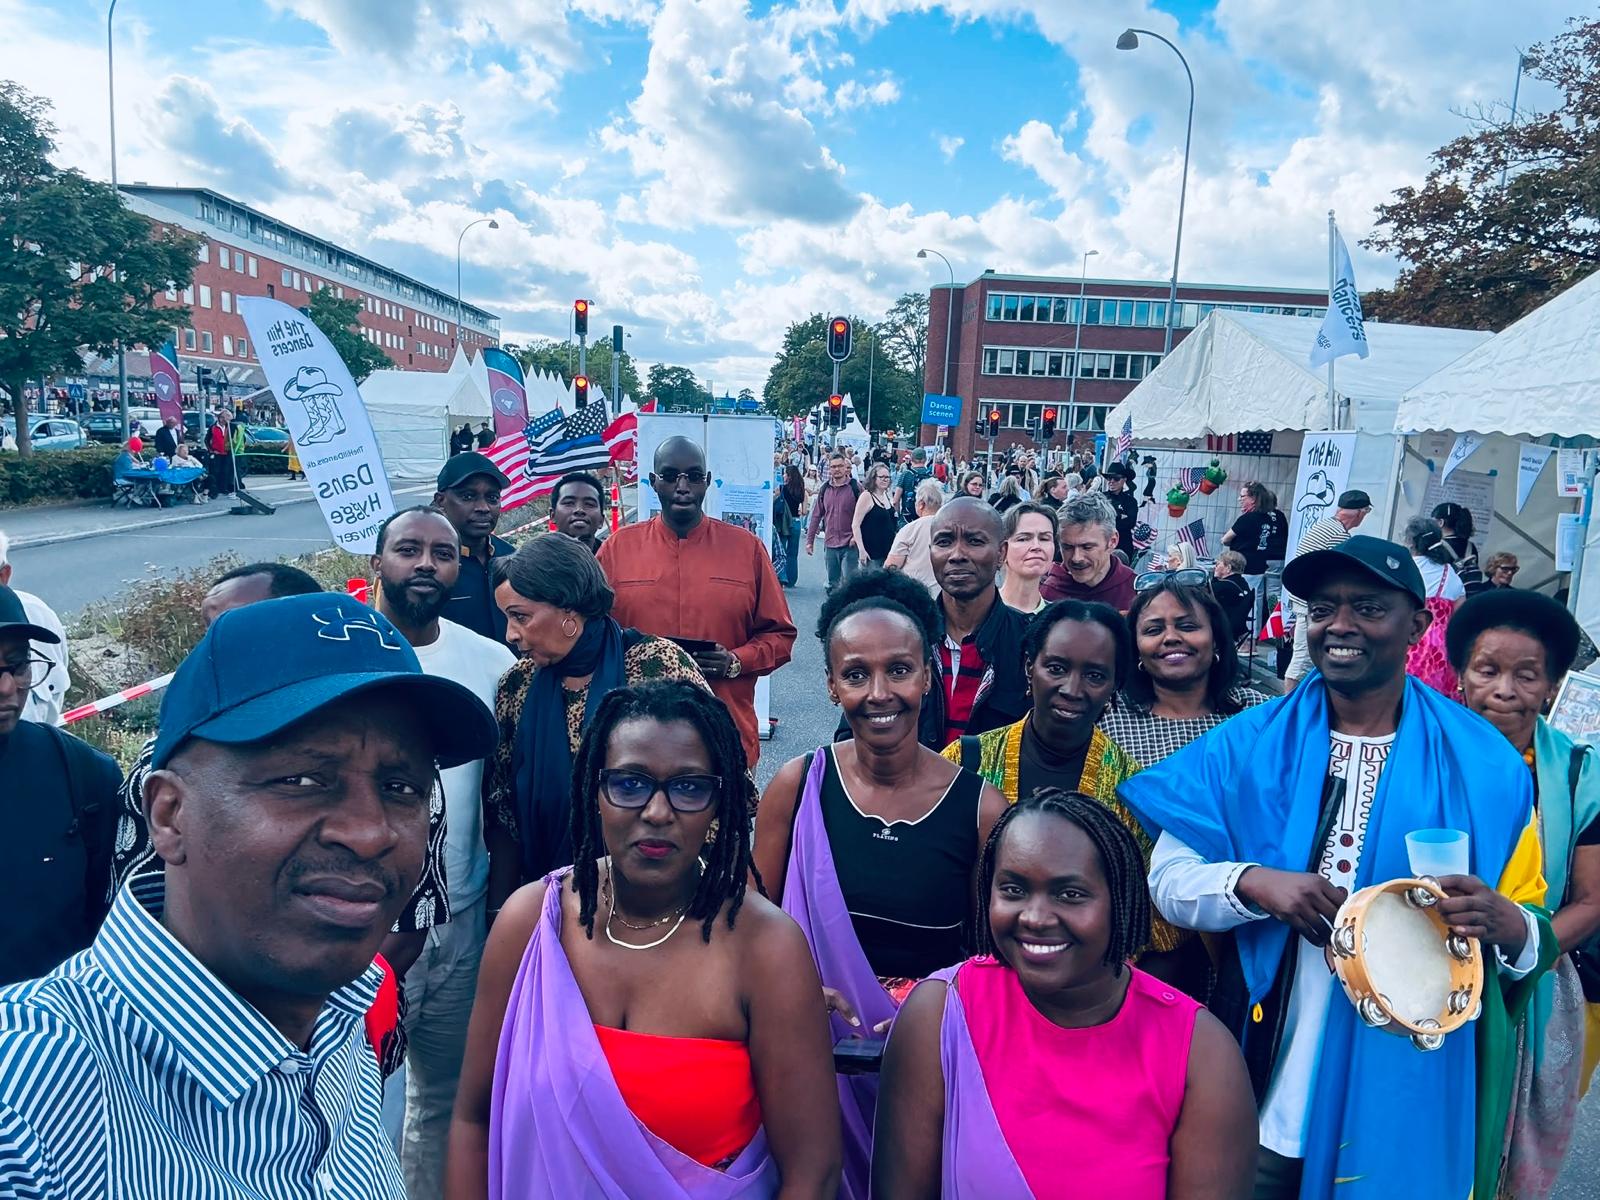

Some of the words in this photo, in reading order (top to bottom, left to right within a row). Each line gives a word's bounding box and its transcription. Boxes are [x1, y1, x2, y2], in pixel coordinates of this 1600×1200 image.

[930, 401, 955, 411] Danse-
[928, 410, 954, 418] scenen
[1308, 441, 1326, 466] The
[1324, 439, 1342, 467] Hill
